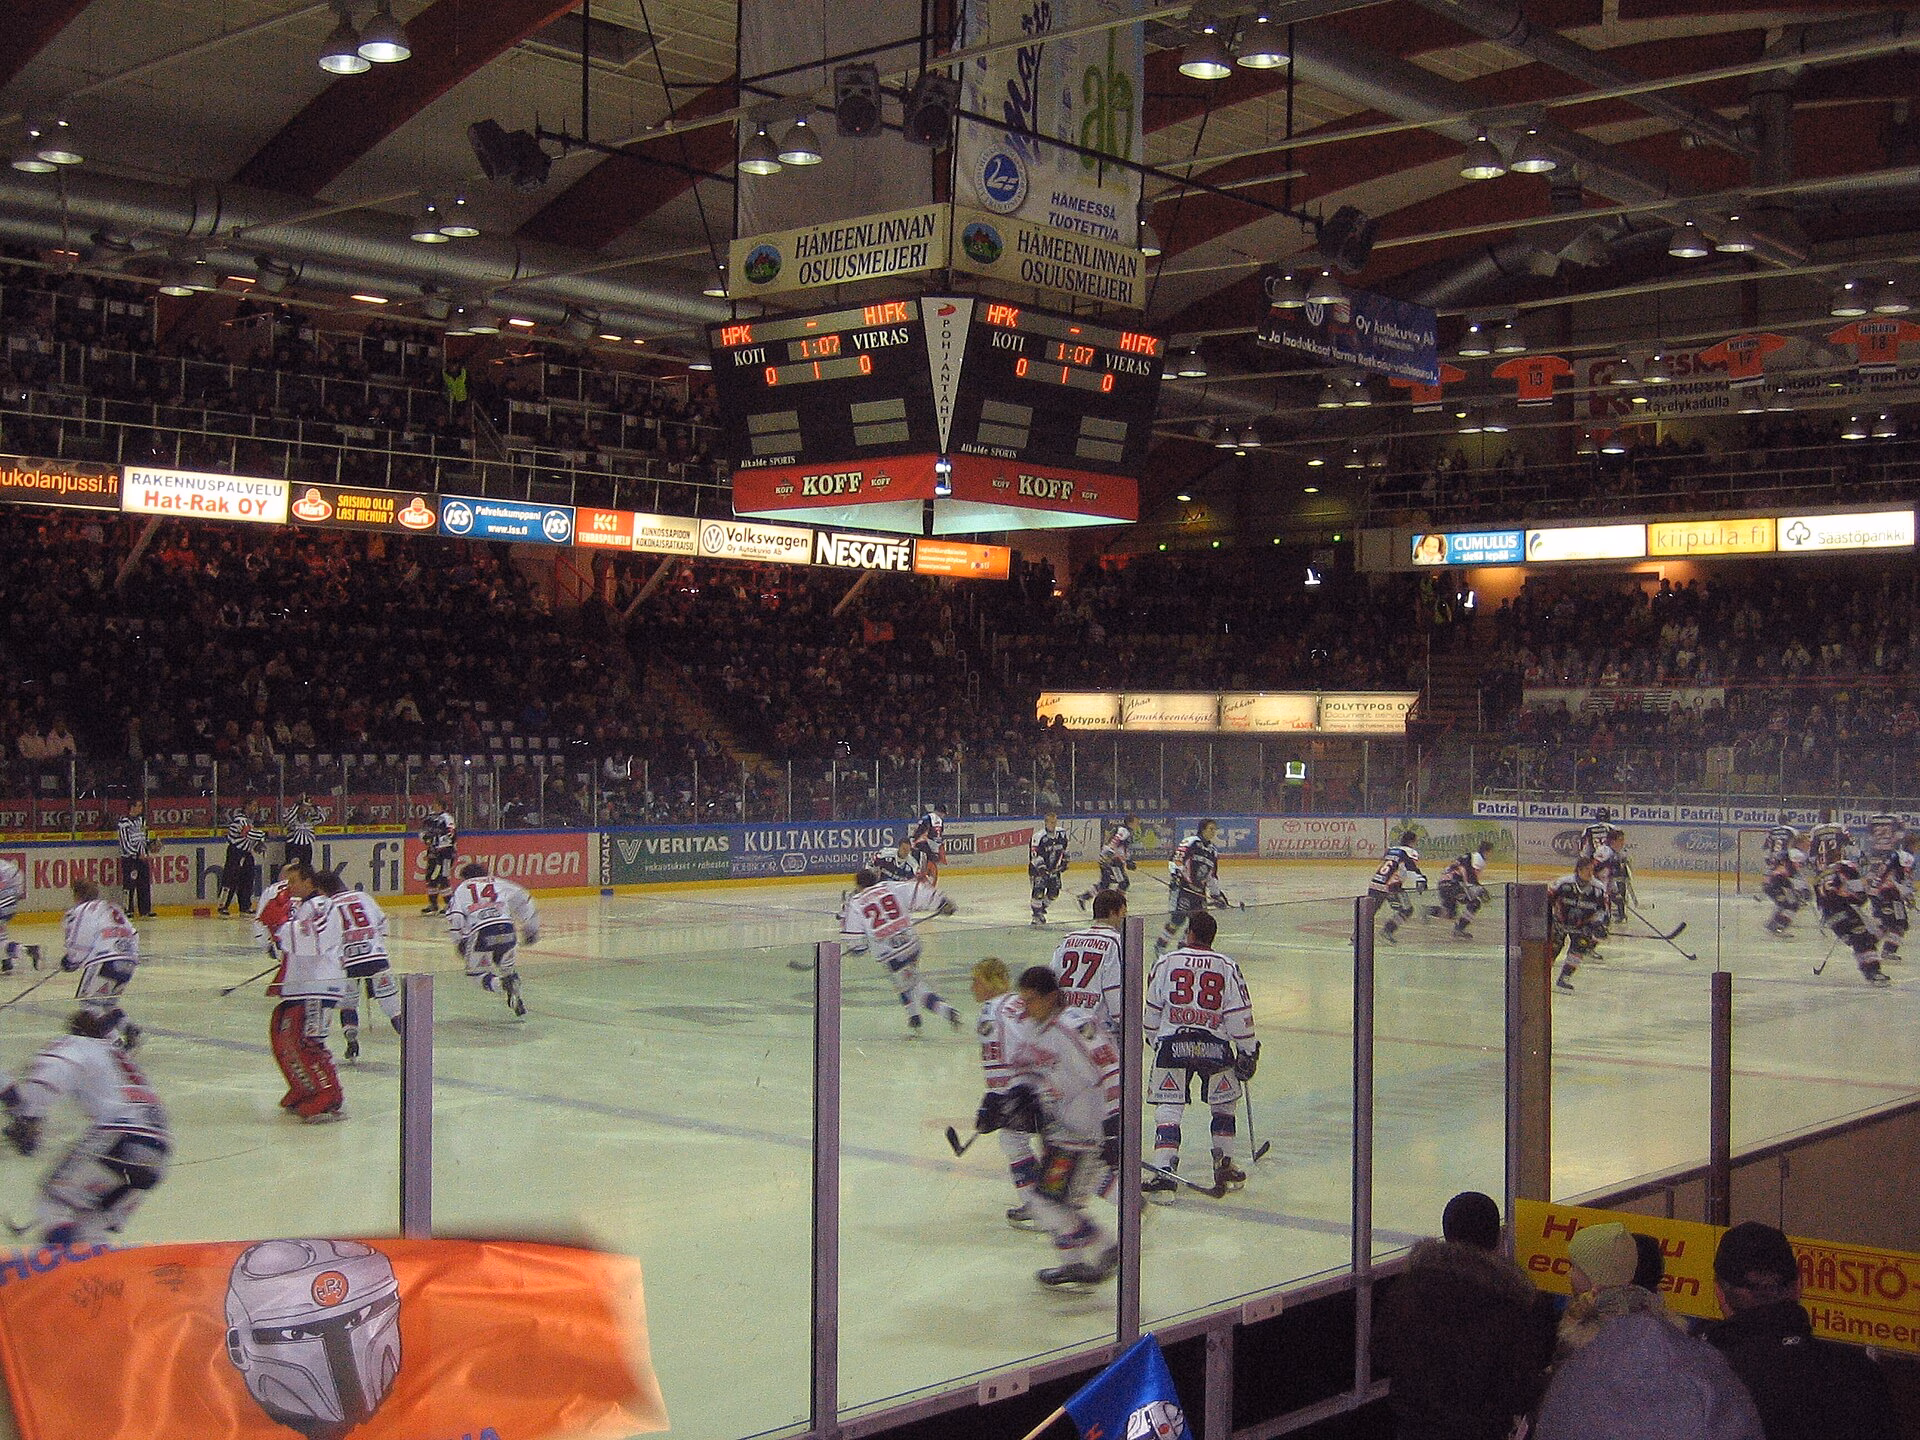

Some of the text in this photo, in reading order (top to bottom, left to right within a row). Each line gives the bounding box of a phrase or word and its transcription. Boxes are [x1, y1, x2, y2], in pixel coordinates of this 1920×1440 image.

[795, 213, 937, 259] HÄMEENLINNAN
[1049, 213, 1119, 242] TUOTETTUA
[799, 243, 928, 285] OSUUSMEIJERI
[1017, 227, 1138, 278] HÄMEENLINNAN
[1020, 261, 1134, 303] OSUUSMEIJERI
[721, 325, 752, 346] HPK
[863, 301, 908, 325] HIFK
[987, 304, 1021, 328] HPK
[1120, 332, 1158, 356] HIFK
[800, 335, 841, 358] 1:07
[852, 327, 909, 350] VIERAS
[992, 331, 1025, 352] KOTI
[733, 347, 767, 367] KOTI
[1057, 343, 1094, 366] 1:07
[1105, 353, 1151, 376] VIERAS
[941, 320, 951, 435] POHJANTAHTI
[769, 456, 796, 465] SPORTS
[991, 447, 1018, 459] SPORTS
[131, 473, 283, 498] RAKENNUSPALVELU
[775, 472, 891, 496] KOFF KOFF KOFF
[1018, 474, 1074, 500] KOFF
[144, 490, 269, 516] Hat-Rak OY
[338, 494, 394, 511] SAISIKO OLLA
[336, 508, 355, 521] LASI
[356, 510, 387, 523] MEHUA
[642, 527, 691, 539] KUNNOSSAPIDON
[726, 527, 809, 550] Volkswagen
[1454, 535, 1518, 550] CUMULUS
[1657, 527, 1766, 552] kiipula.fi
[815, 531, 911, 572] NESCAFÉ
[1325, 703, 1393, 711] POLYTYPOS
[1477, 802, 1518, 814] Patria
[1529, 804, 1569, 816] Patria
[1629, 807, 1670, 819] Patria
[1680, 809, 1722, 820] Patria
[1734, 810, 1776, 822] Patria
[1304, 821, 1357, 832] TOYOTA
[645, 836, 730, 854] VERITAS
[744, 828, 894, 851] KULTAKESKUS
[601, 832, 611, 885] CANAL+
[467, 883, 498, 905] 14
[1059, 951, 1103, 988] 27
[1184, 957, 1211, 969] ZION
[1169, 968, 1225, 1010] 38
[1169, 1007, 1223, 1030] KOFF
